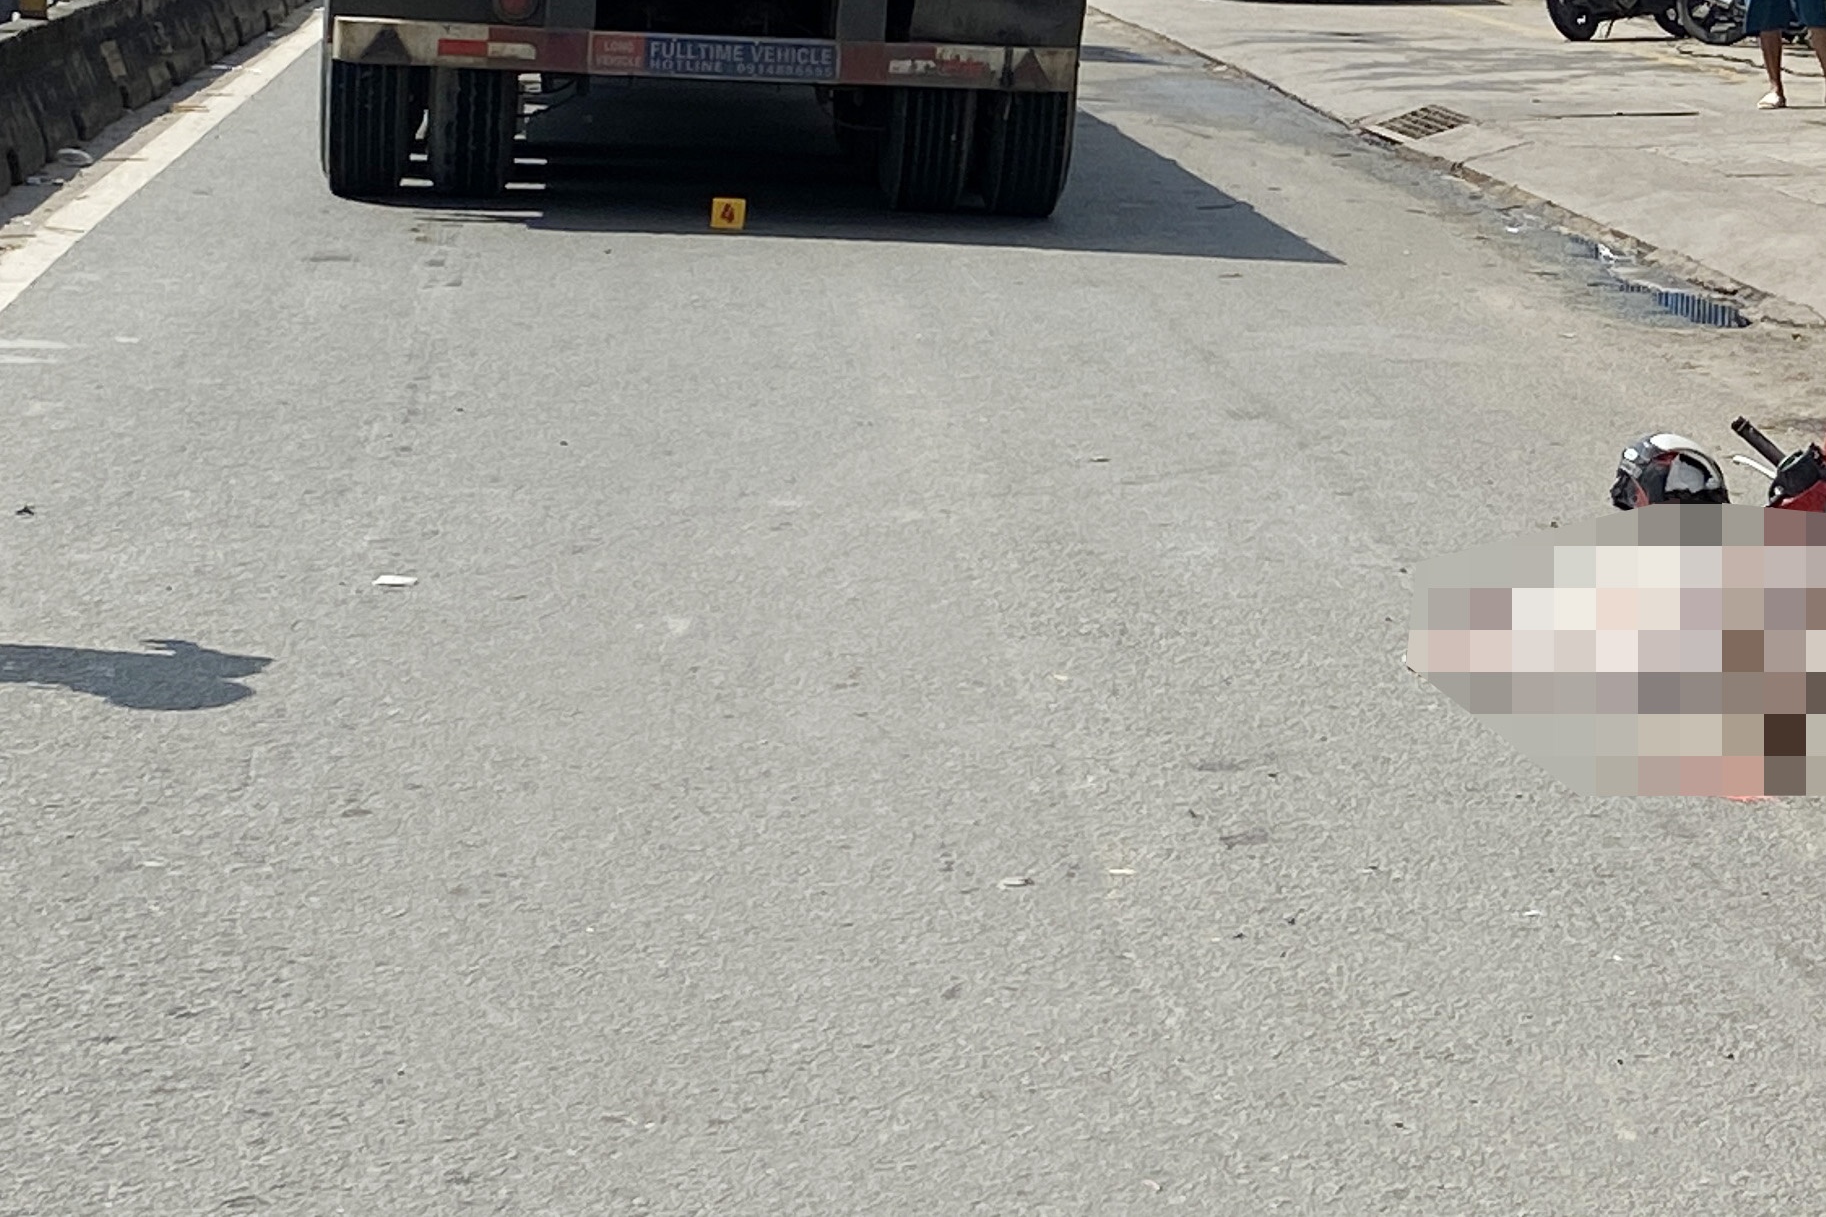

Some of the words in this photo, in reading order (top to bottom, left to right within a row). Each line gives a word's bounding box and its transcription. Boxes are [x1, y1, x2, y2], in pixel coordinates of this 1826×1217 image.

[650, 59, 724, 73] HOTLINE
[751, 44, 833, 66] VEHICLE
[719, 202, 735, 224] 4
